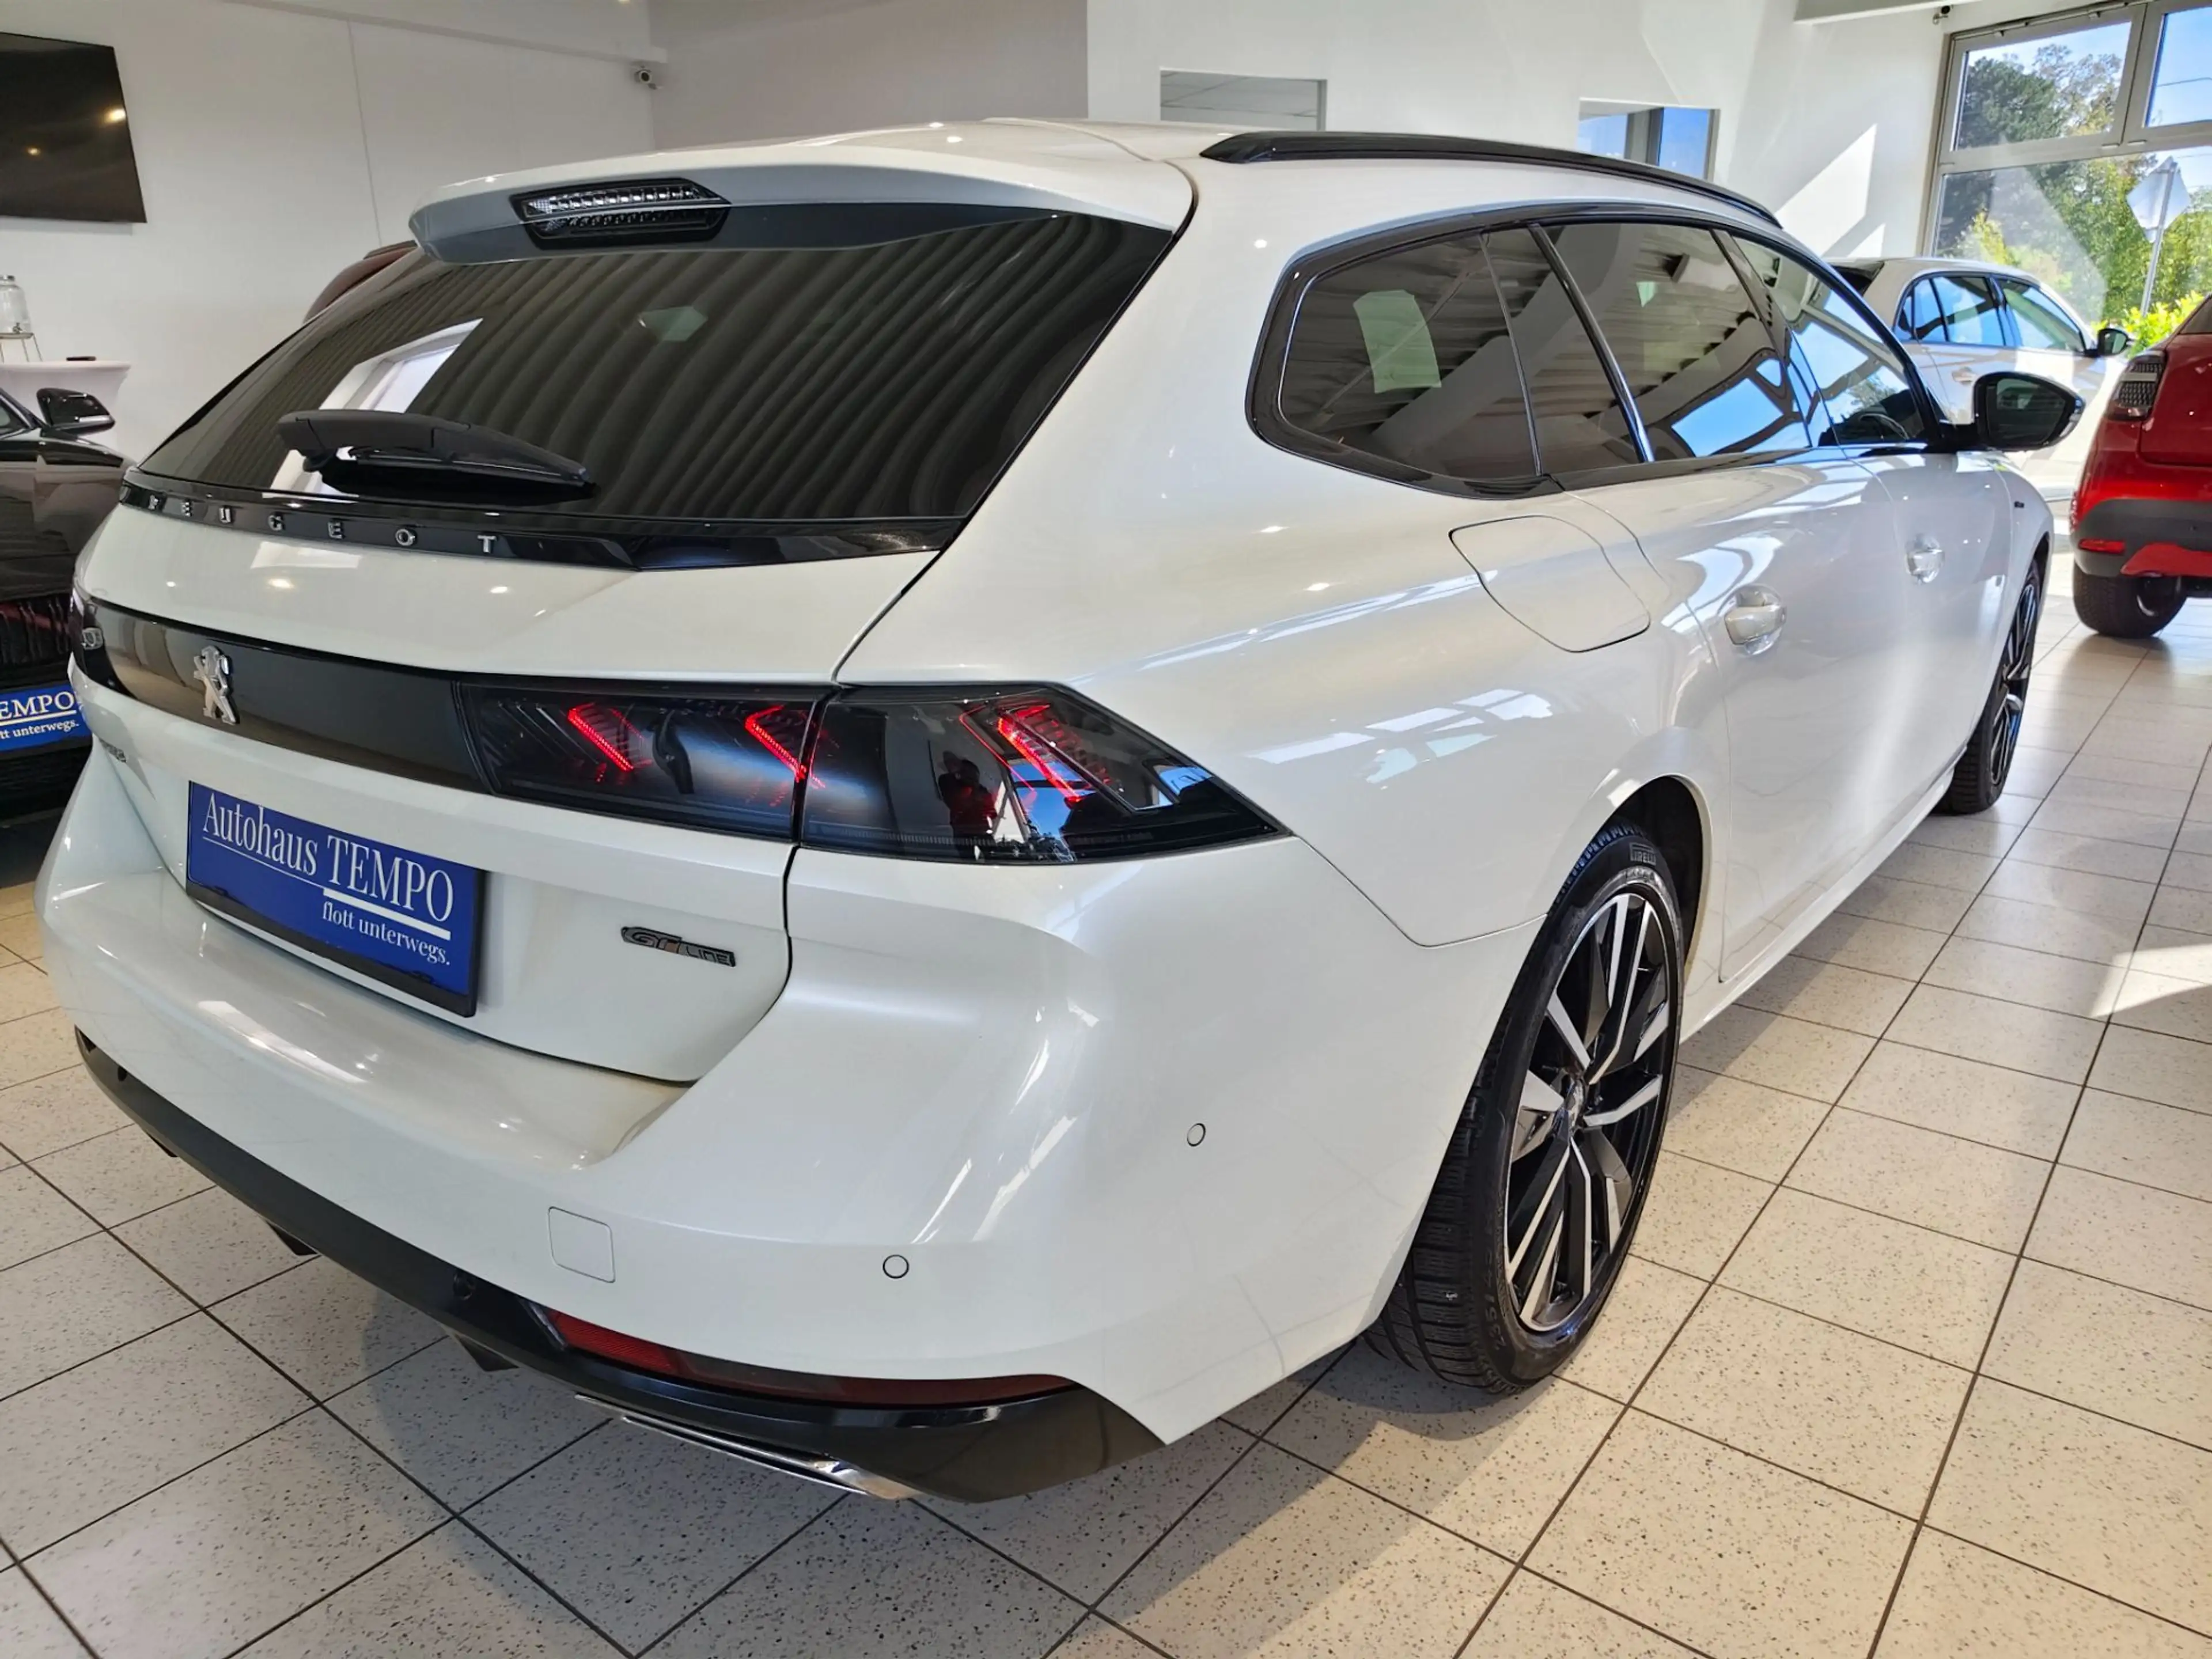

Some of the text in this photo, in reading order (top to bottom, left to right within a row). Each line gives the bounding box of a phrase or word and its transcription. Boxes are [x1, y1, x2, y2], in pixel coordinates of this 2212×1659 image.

[148, 494, 497, 553] PEUGEOT
[13, 719, 79, 737] unterwegs.
[203, 792, 454, 922] Autohaus TEMPO
[323, 901, 450, 966] flott unterwegs.
[622, 926, 681, 954] GT
